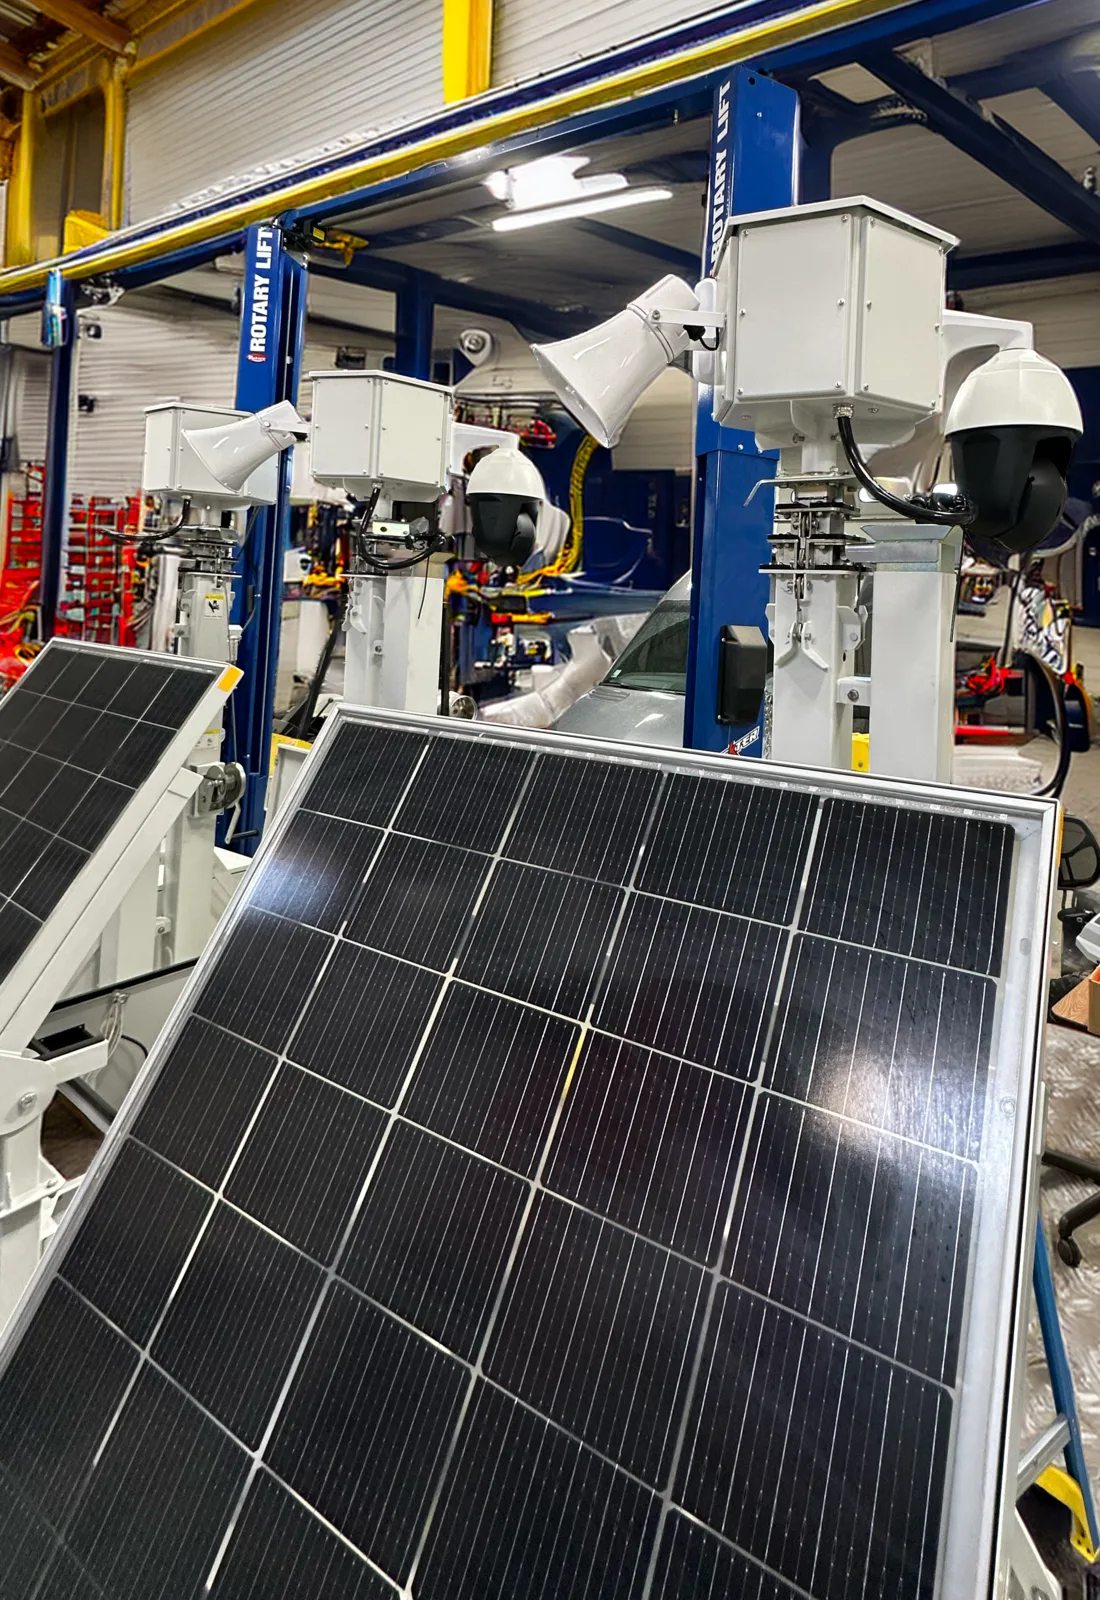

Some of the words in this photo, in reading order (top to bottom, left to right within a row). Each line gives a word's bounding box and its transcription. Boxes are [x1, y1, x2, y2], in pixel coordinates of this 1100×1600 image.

[717, 80, 731, 143] LIFT
[711, 149, 727, 264] ROTARY
[255, 228, 274, 269] LIFT
[250, 274, 270, 352] ROTARY
